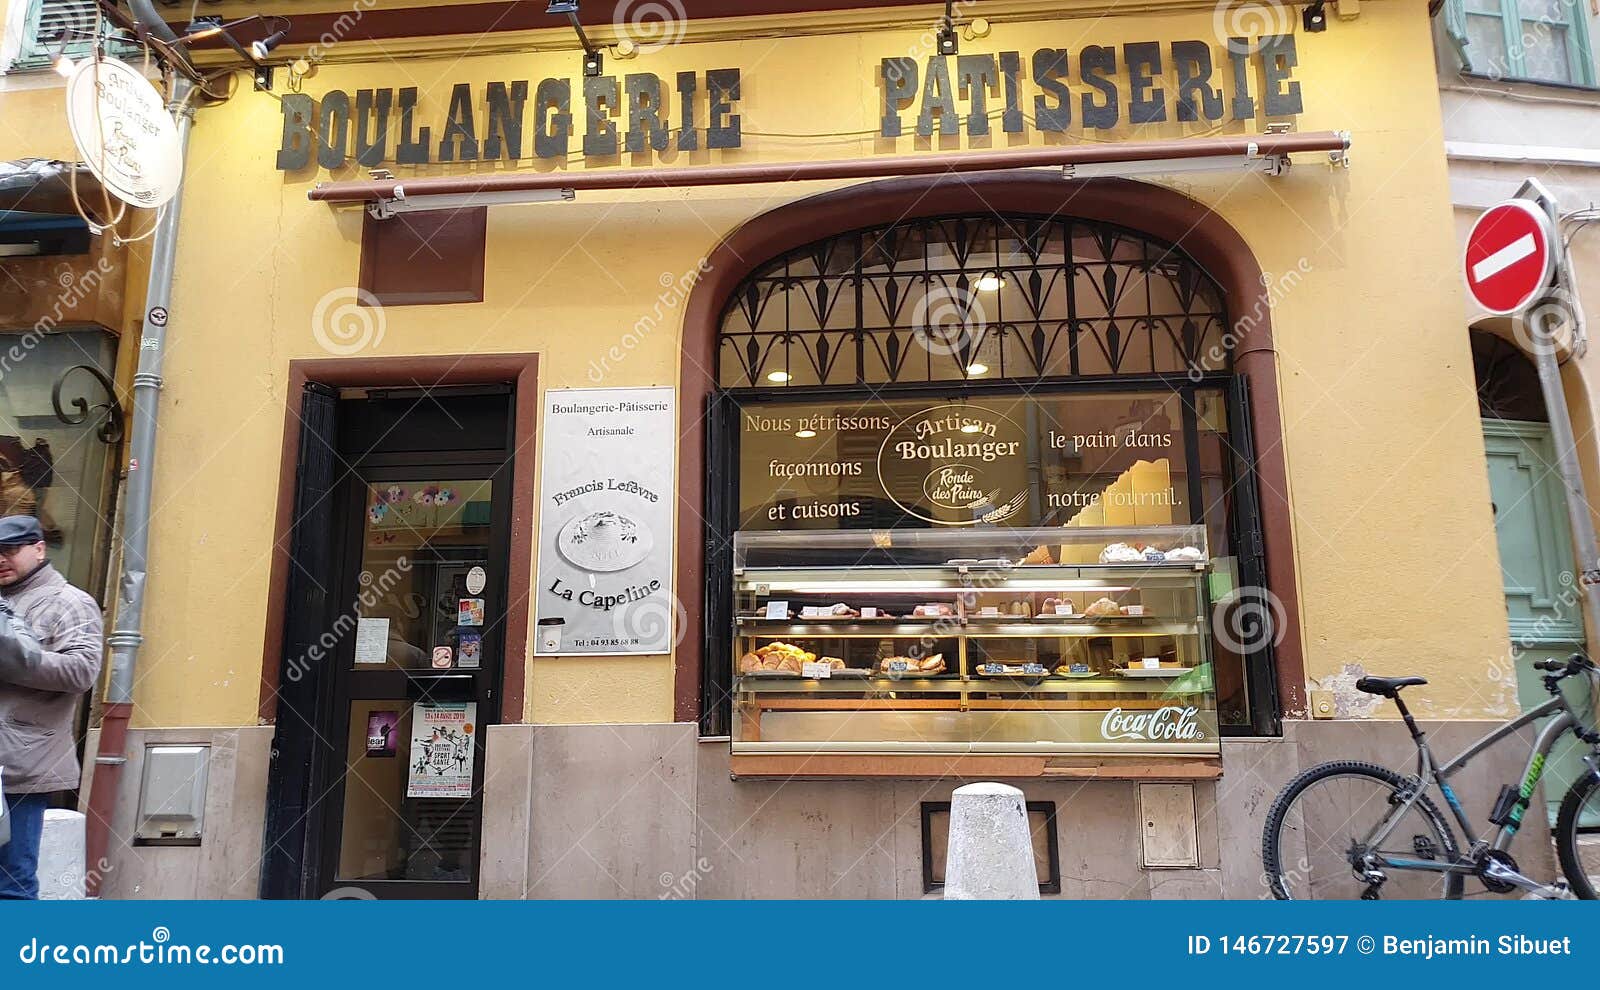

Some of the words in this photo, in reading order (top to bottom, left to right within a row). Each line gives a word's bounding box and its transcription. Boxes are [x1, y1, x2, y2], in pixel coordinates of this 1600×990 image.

[276, 68, 742, 170] BOULANGERIE
[552, 401, 668, 415] Boulangerie-Pâtisserie
[587, 426, 634, 436] Artisanale
[746, 415, 791, 432] Nous
[799, 414, 895, 435] pétrissons,
[915, 413, 997, 440] Artisan
[895, 438, 1020, 462] Boulanger
[1049, 431, 1066, 448] le
[1073, 431, 1118, 452] pain
[1125, 429, 1172, 447] dans
[769, 460, 862, 480] façonnons
[940, 468, 974, 487] Ronde
[552, 479, 604, 506] Francis
[607, 478, 659, 503] Lefèvre
[932, 488, 951, 500] des
[951, 485, 983, 503] Pains
[1048, 491, 1100, 507] notre
[1107, 487, 1182, 506] fournil.
[768, 506, 785, 520] et
[792, 502, 860, 519] cuisons
[549, 579, 574, 601] La
[579, 579, 661, 611] Capeline
